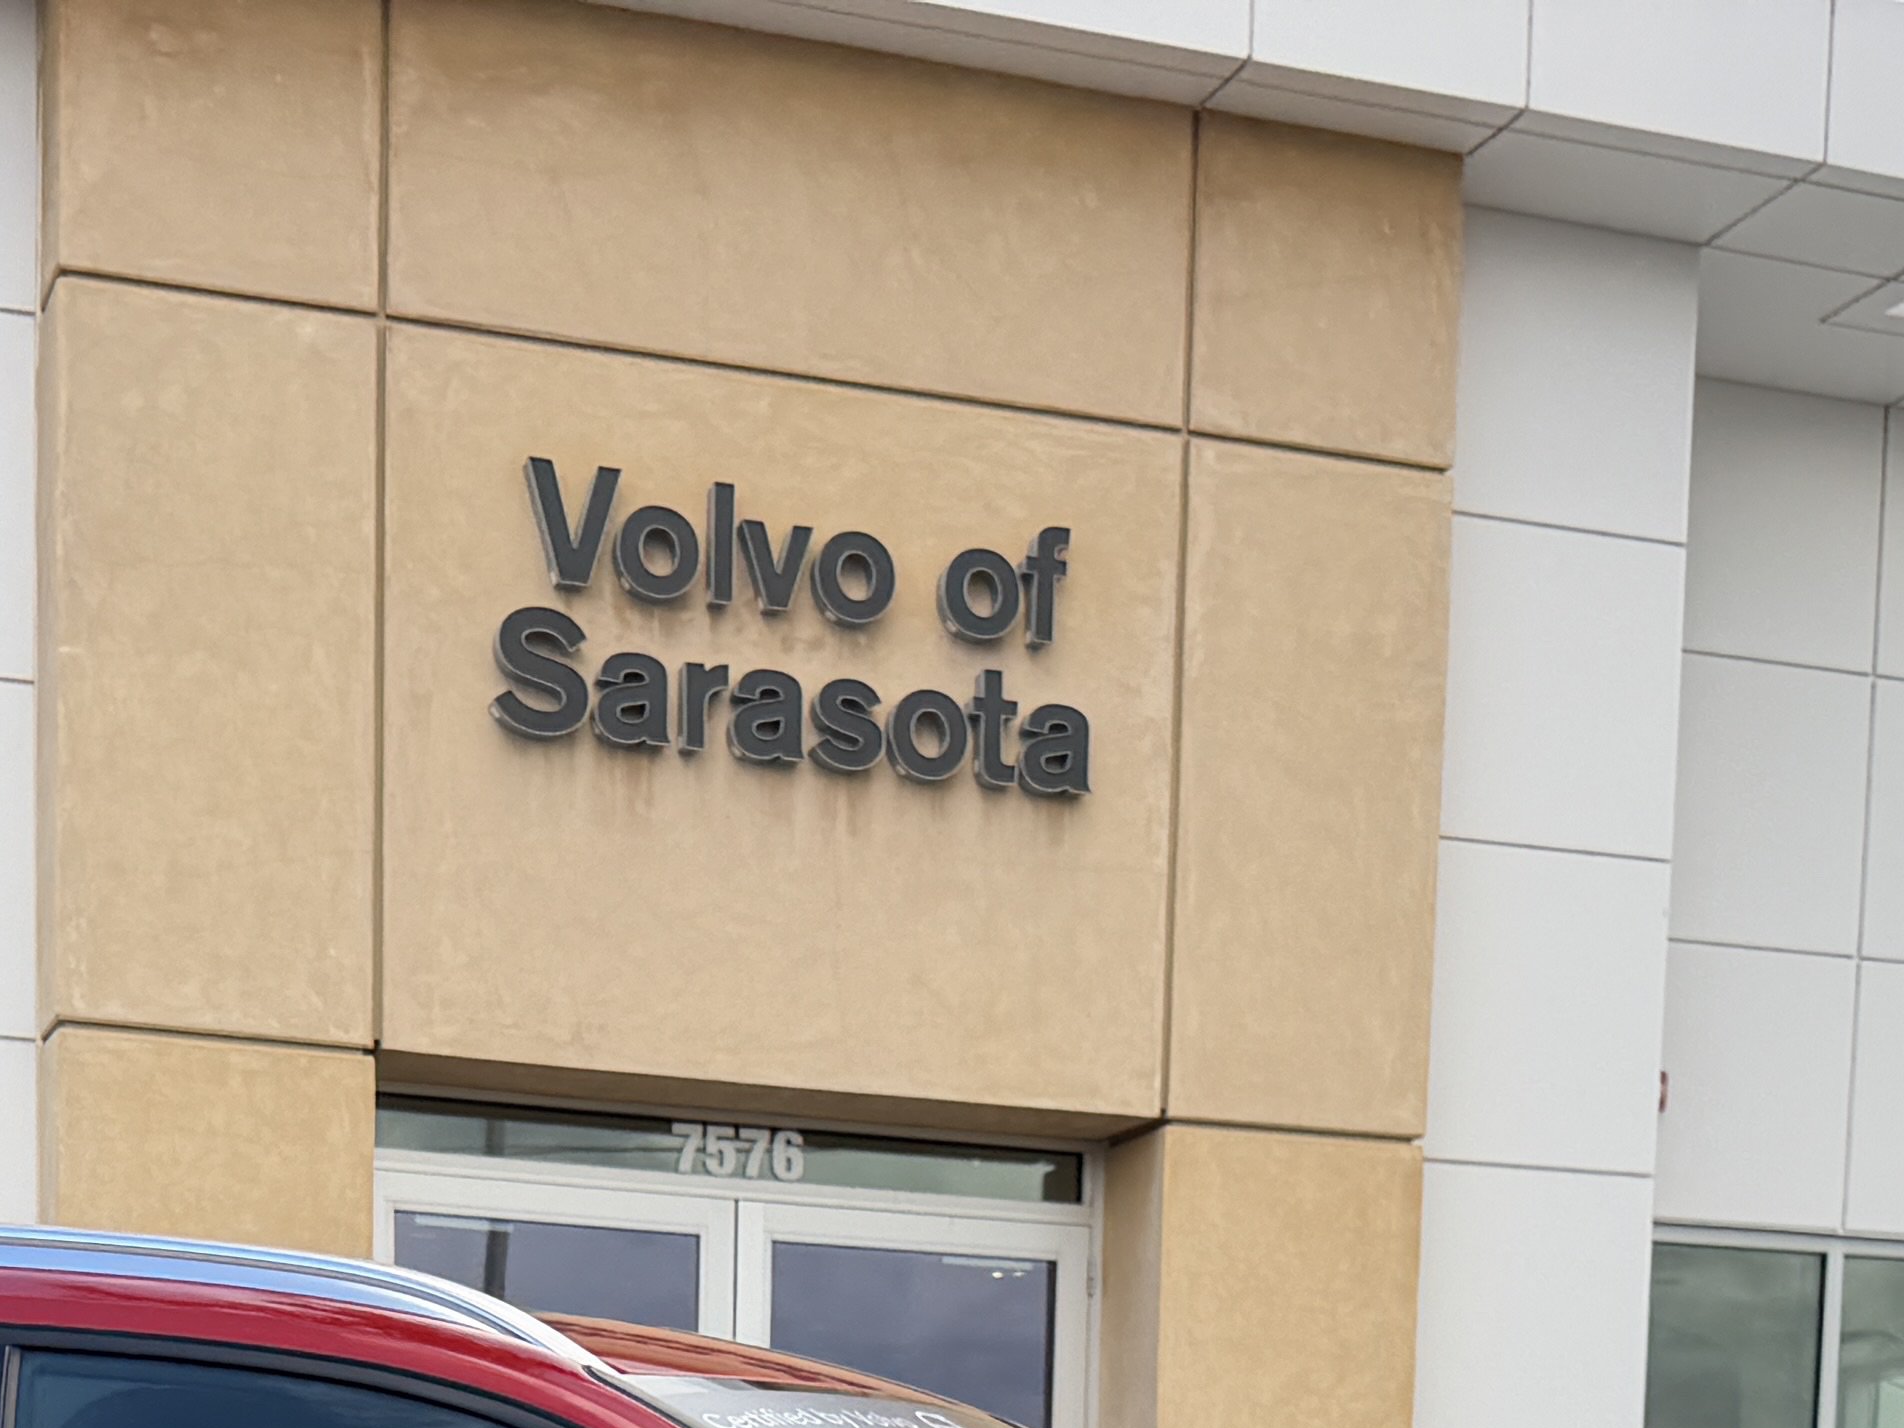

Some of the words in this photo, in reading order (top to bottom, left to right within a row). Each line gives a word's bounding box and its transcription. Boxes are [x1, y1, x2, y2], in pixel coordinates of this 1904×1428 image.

[523, 456, 896, 626] Volvo
[936, 526, 1072, 650] of
[489, 606, 1092, 796] Sarasota
[671, 1121, 804, 1180] 7576
